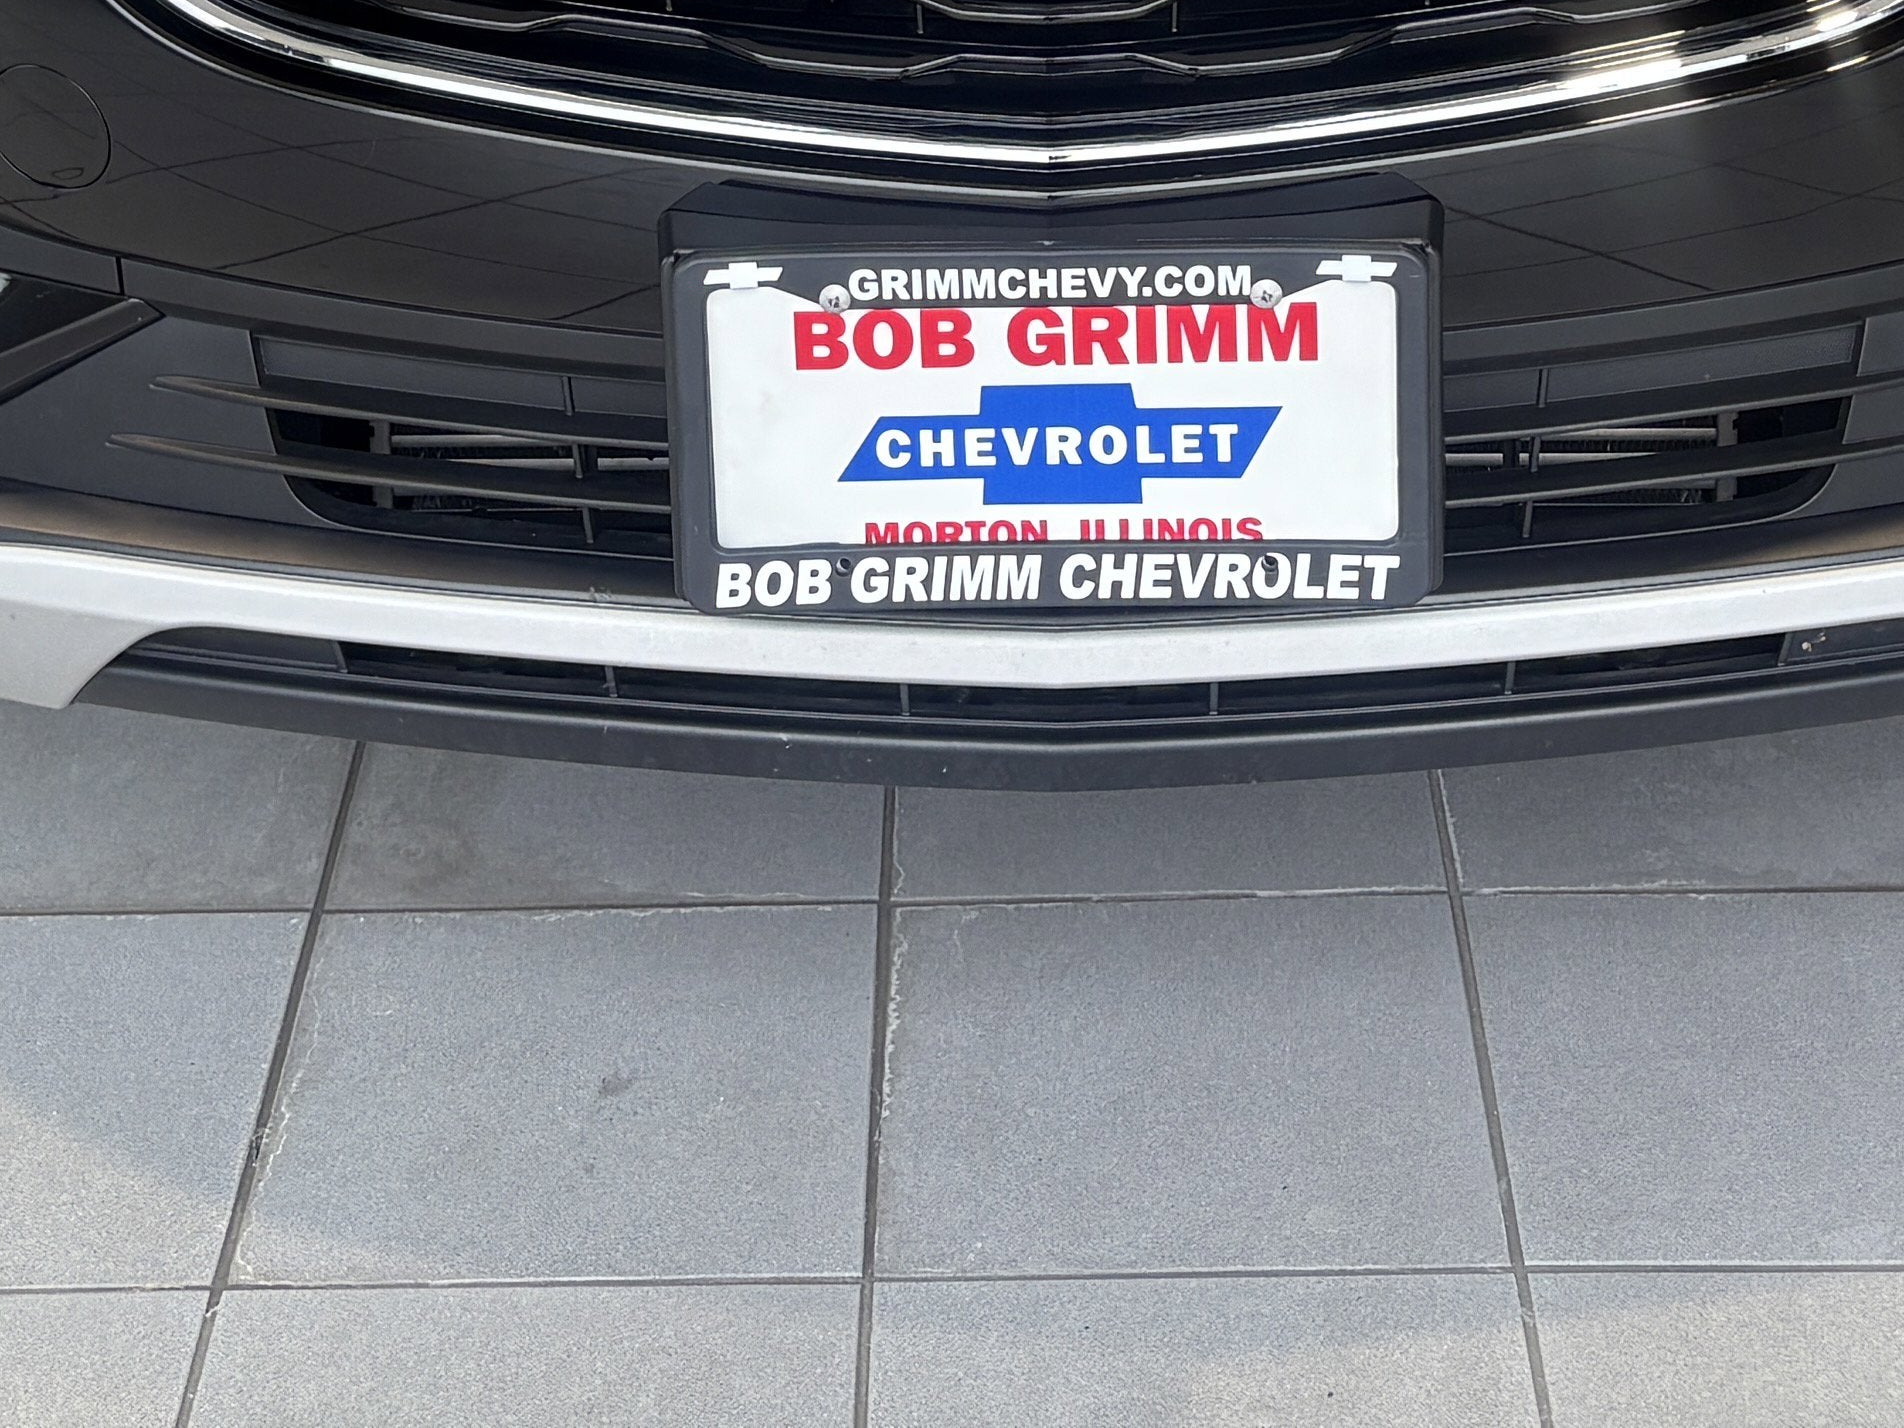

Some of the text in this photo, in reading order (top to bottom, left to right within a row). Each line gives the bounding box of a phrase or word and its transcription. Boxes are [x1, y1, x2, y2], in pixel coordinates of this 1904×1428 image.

[848, 265, 1252, 301] GRIMMCHEVY.COM
[794, 301, 1318, 370] BOB GRIMM
[875, 423, 1239, 468] CHEVROLET
[715, 552, 1401, 609] BOB GRIMM CHEVROLET
